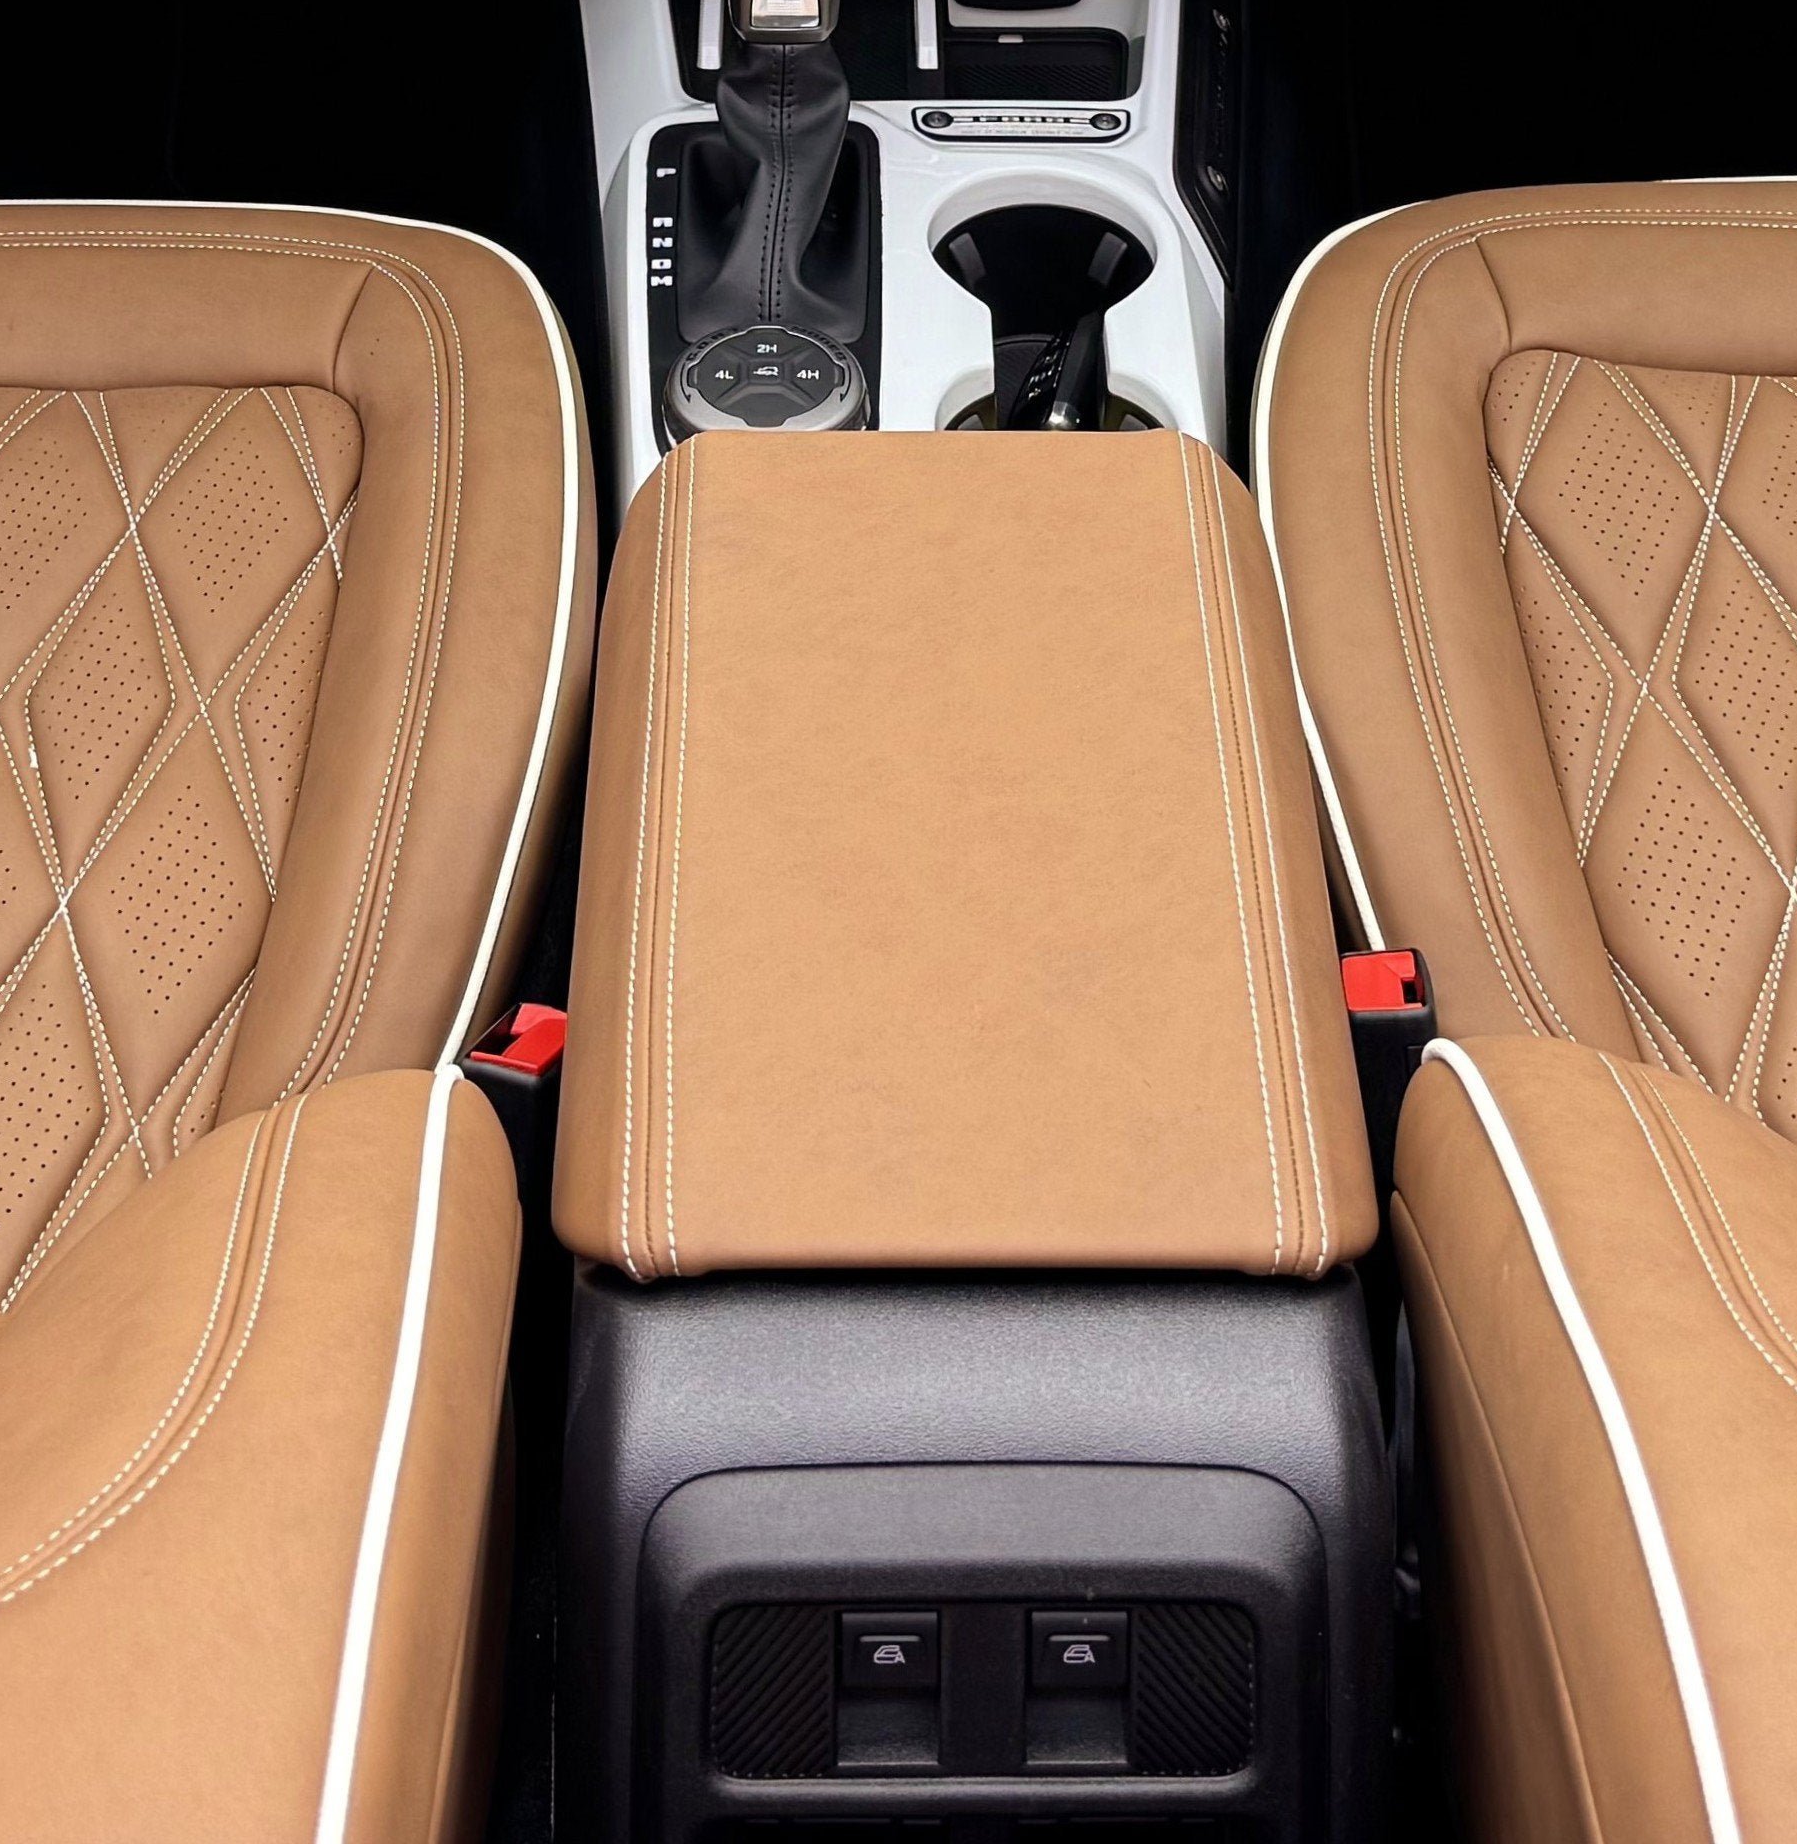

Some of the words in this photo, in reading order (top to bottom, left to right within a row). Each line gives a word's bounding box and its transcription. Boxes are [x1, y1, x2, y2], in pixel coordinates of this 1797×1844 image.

[756, 343, 778, 354] 2H
[714, 369, 734, 380] 4L
[796, 369, 820, 380] 4H
